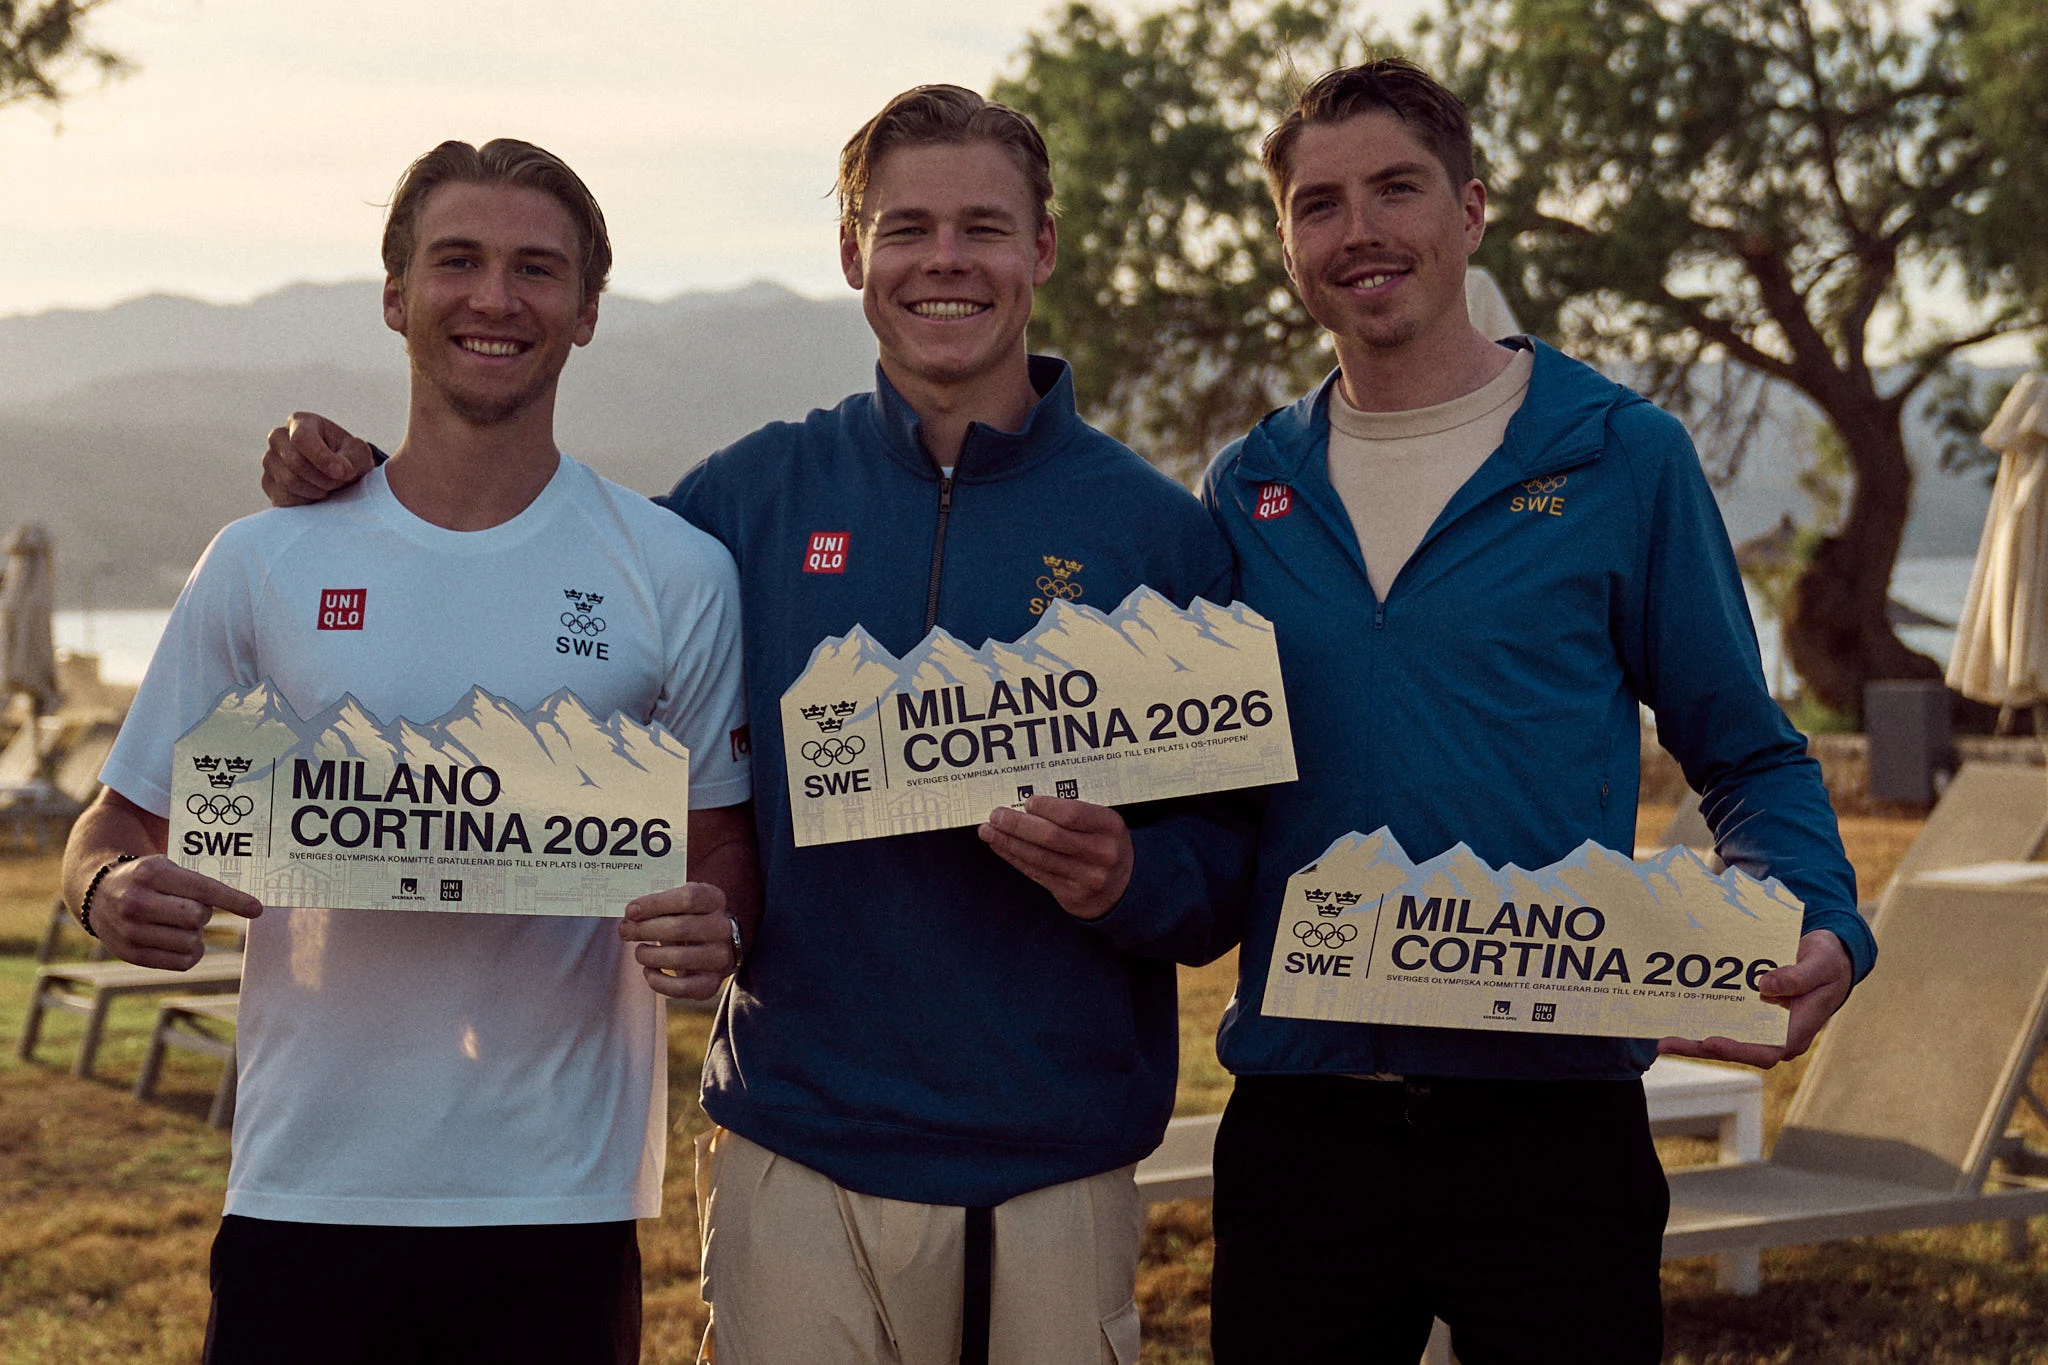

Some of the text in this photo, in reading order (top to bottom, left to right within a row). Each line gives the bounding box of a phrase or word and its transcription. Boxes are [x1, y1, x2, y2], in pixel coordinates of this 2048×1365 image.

[1263, 485, 1287, 500] UNI
[1259, 497, 1288, 518] QLO
[1510, 497, 1565, 516] SWE
[813, 537, 843, 551] UNI
[808, 554, 842, 570] QLO
[325, 594, 358, 608] UNI
[323, 611, 359, 628] QLO
[556, 637, 609, 660] SWE
[897, 669, 1098, 730] MILANO
[903, 690, 1273, 772] CORTINA 2026
[906, 775, 949, 787] SVERIGES
[950, 769, 999, 781] OLYMPISKA
[1048, 755, 1104, 768] GRATULERAR
[1106, 752, 1122, 760] DIG
[1124, 749, 1142, 758] TILL
[1144, 747, 1156, 755] EN
[1158, 743, 1184, 753] PLATS
[1191, 735, 1248, 749] OS-TRUPPEN!
[292, 758, 500, 806] MILANO
[804, 769, 872, 799] SWE
[1058, 781, 1074, 790] UNI
[290, 805, 672, 857] CORTINA 2026
[183, 831, 253, 857] SWE
[289, 852, 333, 861] SVERIGES
[335, 854, 385, 862] OLYMPISKA
[437, 857, 495, 866] GRATULERAR
[584, 862, 643, 870] OS-TRUPPEN!
[442, 891, 460, 899] QLO
[1396, 896, 1606, 942] MILANO
[1284, 951, 1353, 978] SWE
[1391, 934, 1778, 992] CORTINA 2026
[1386, 974, 1429, 983] SVERIGES
[1431, 977, 1481, 987] OLYMPISKA
[1532, 984, 1591, 993] GRATULERAR
[1647, 990, 1676, 998] PLATS
[1683, 993, 1746, 1002] OS-TRUPPEN!
[1534, 1012, 1553, 1020] QLO
[1535, 1004, 1553, 1012] UNI
